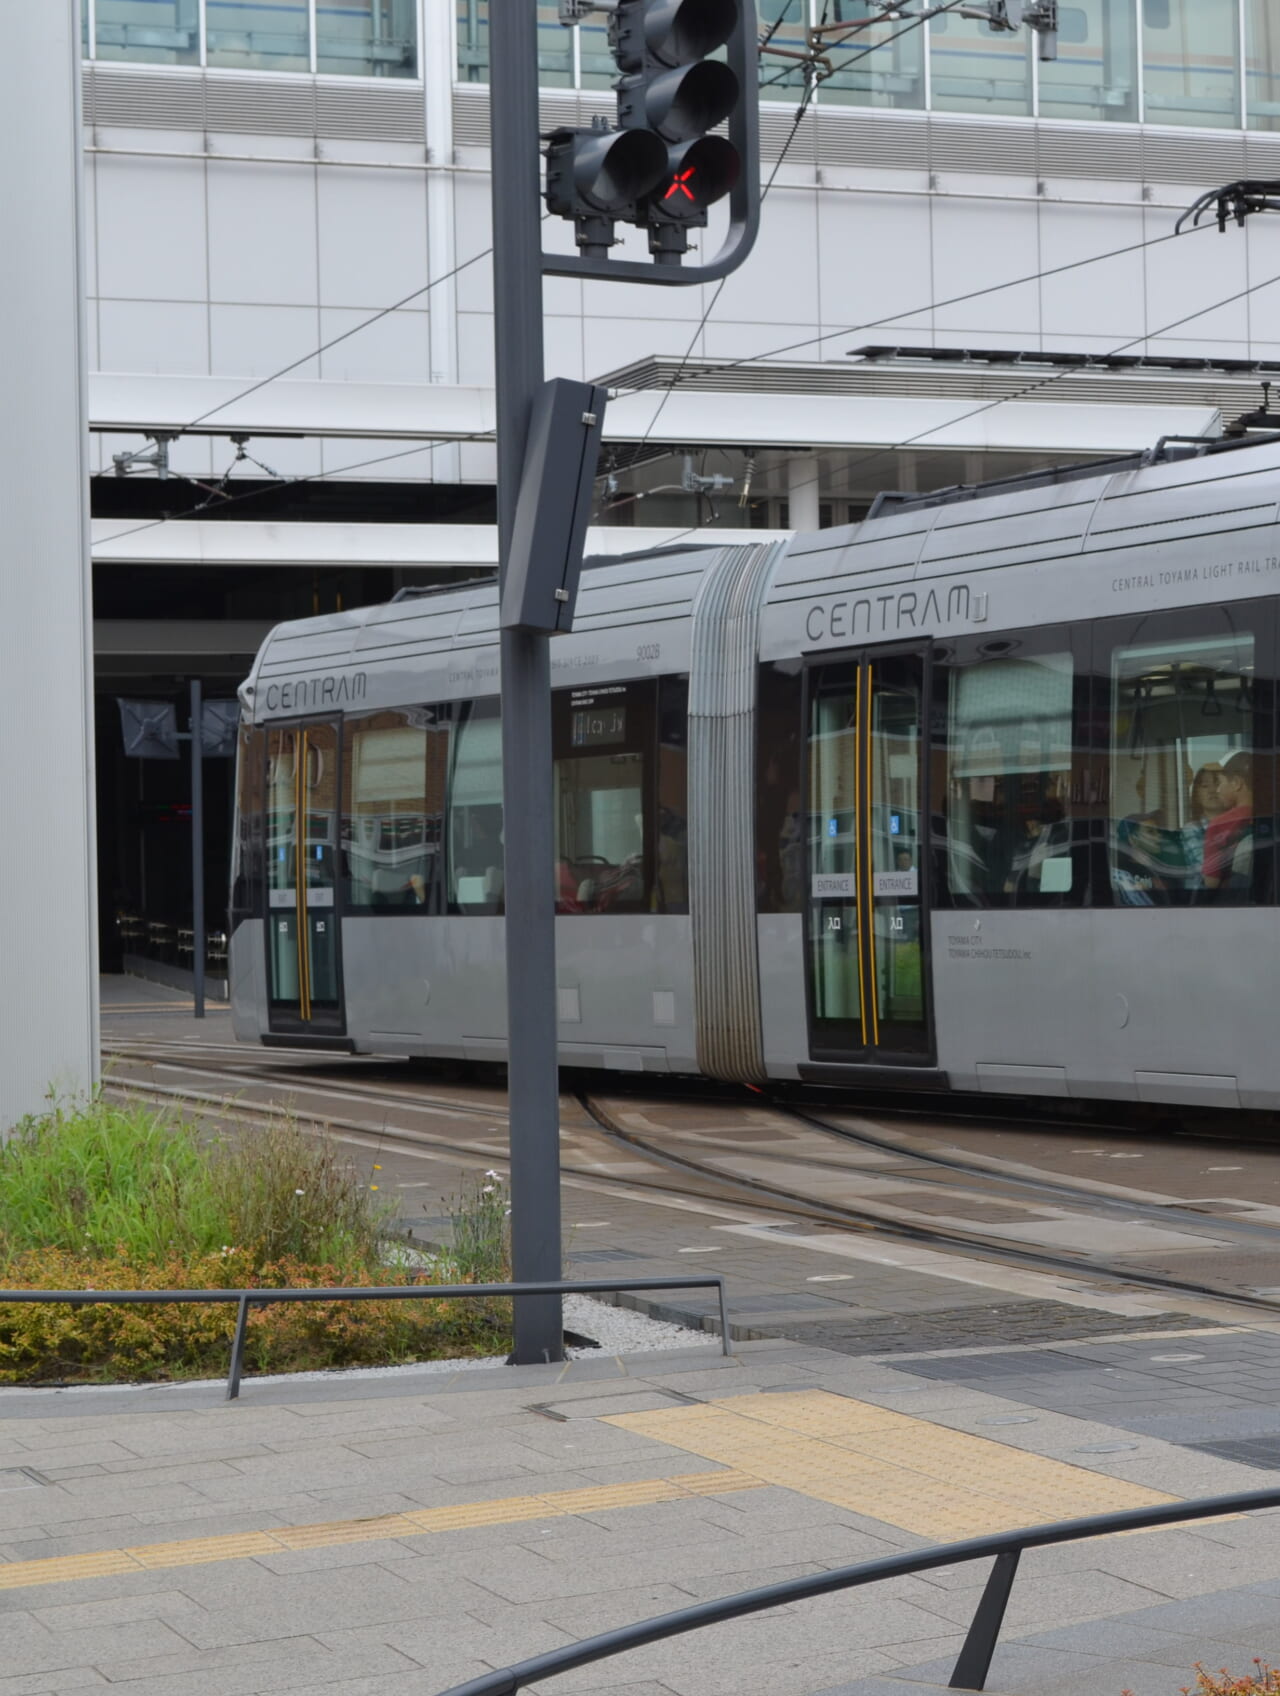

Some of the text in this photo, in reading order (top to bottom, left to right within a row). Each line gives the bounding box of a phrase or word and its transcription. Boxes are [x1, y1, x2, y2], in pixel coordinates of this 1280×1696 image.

[1112, 576, 1154, 592] CENTRAL
[1159, 569, 1198, 585] TOYAMA
[1203, 563, 1232, 580] LIGHT
[1238, 560, 1261, 574] RAIL
[806, 584, 969, 641] CENTRAM
[266, 672, 366, 711] CENTRAM
[817, 879, 849, 892] ENTRANCE
[879, 878, 912, 890] ENTRANCE
